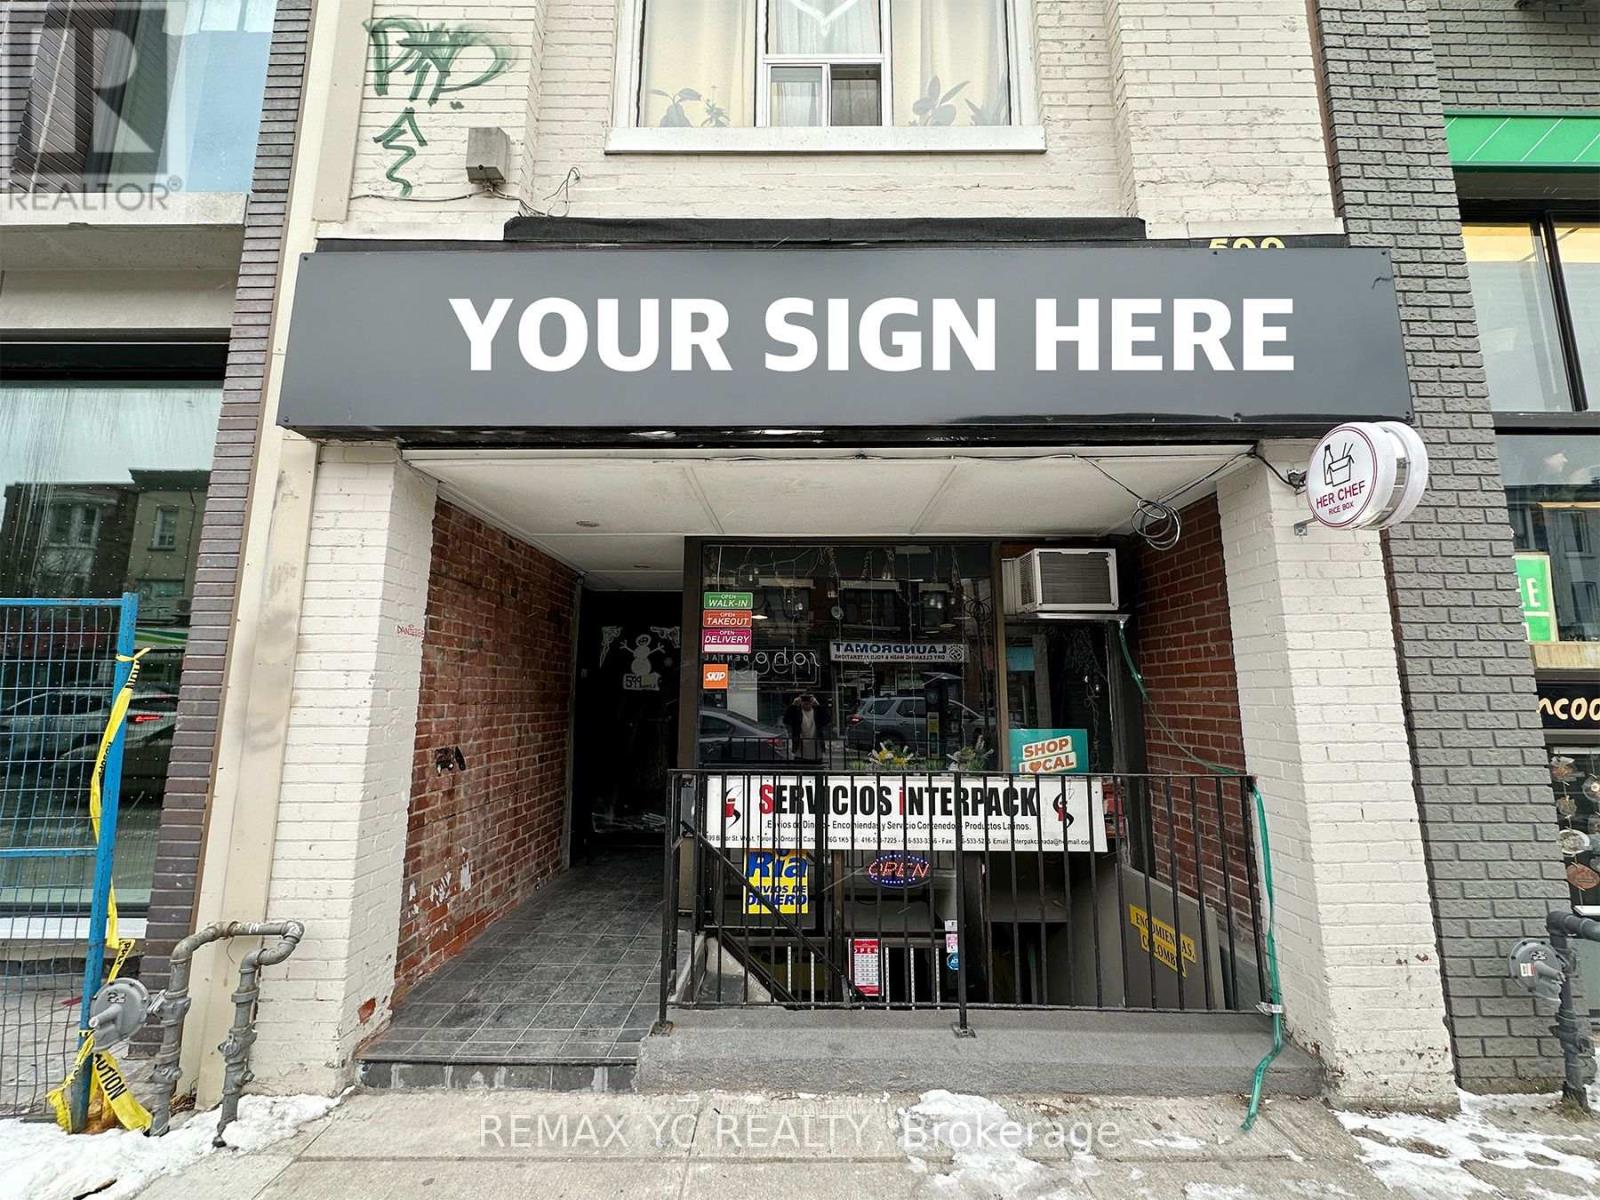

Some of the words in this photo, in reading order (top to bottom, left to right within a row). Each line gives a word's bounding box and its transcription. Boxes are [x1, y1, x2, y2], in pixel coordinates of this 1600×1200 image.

[448, 297, 734, 372] YOUR
[765, 297, 996, 372] SIGN
[1035, 298, 1295, 371] HERE
[1316, 492, 1335, 509] HER
[1337, 480, 1366, 501] CHEF
[1328, 505, 1341, 515] RICE
[1342, 501, 1354, 511] BOX
[705, 635, 750, 643] DELIVERY
[706, 672, 726, 680] SKIP
[1024, 738, 1069, 758] SHOP
